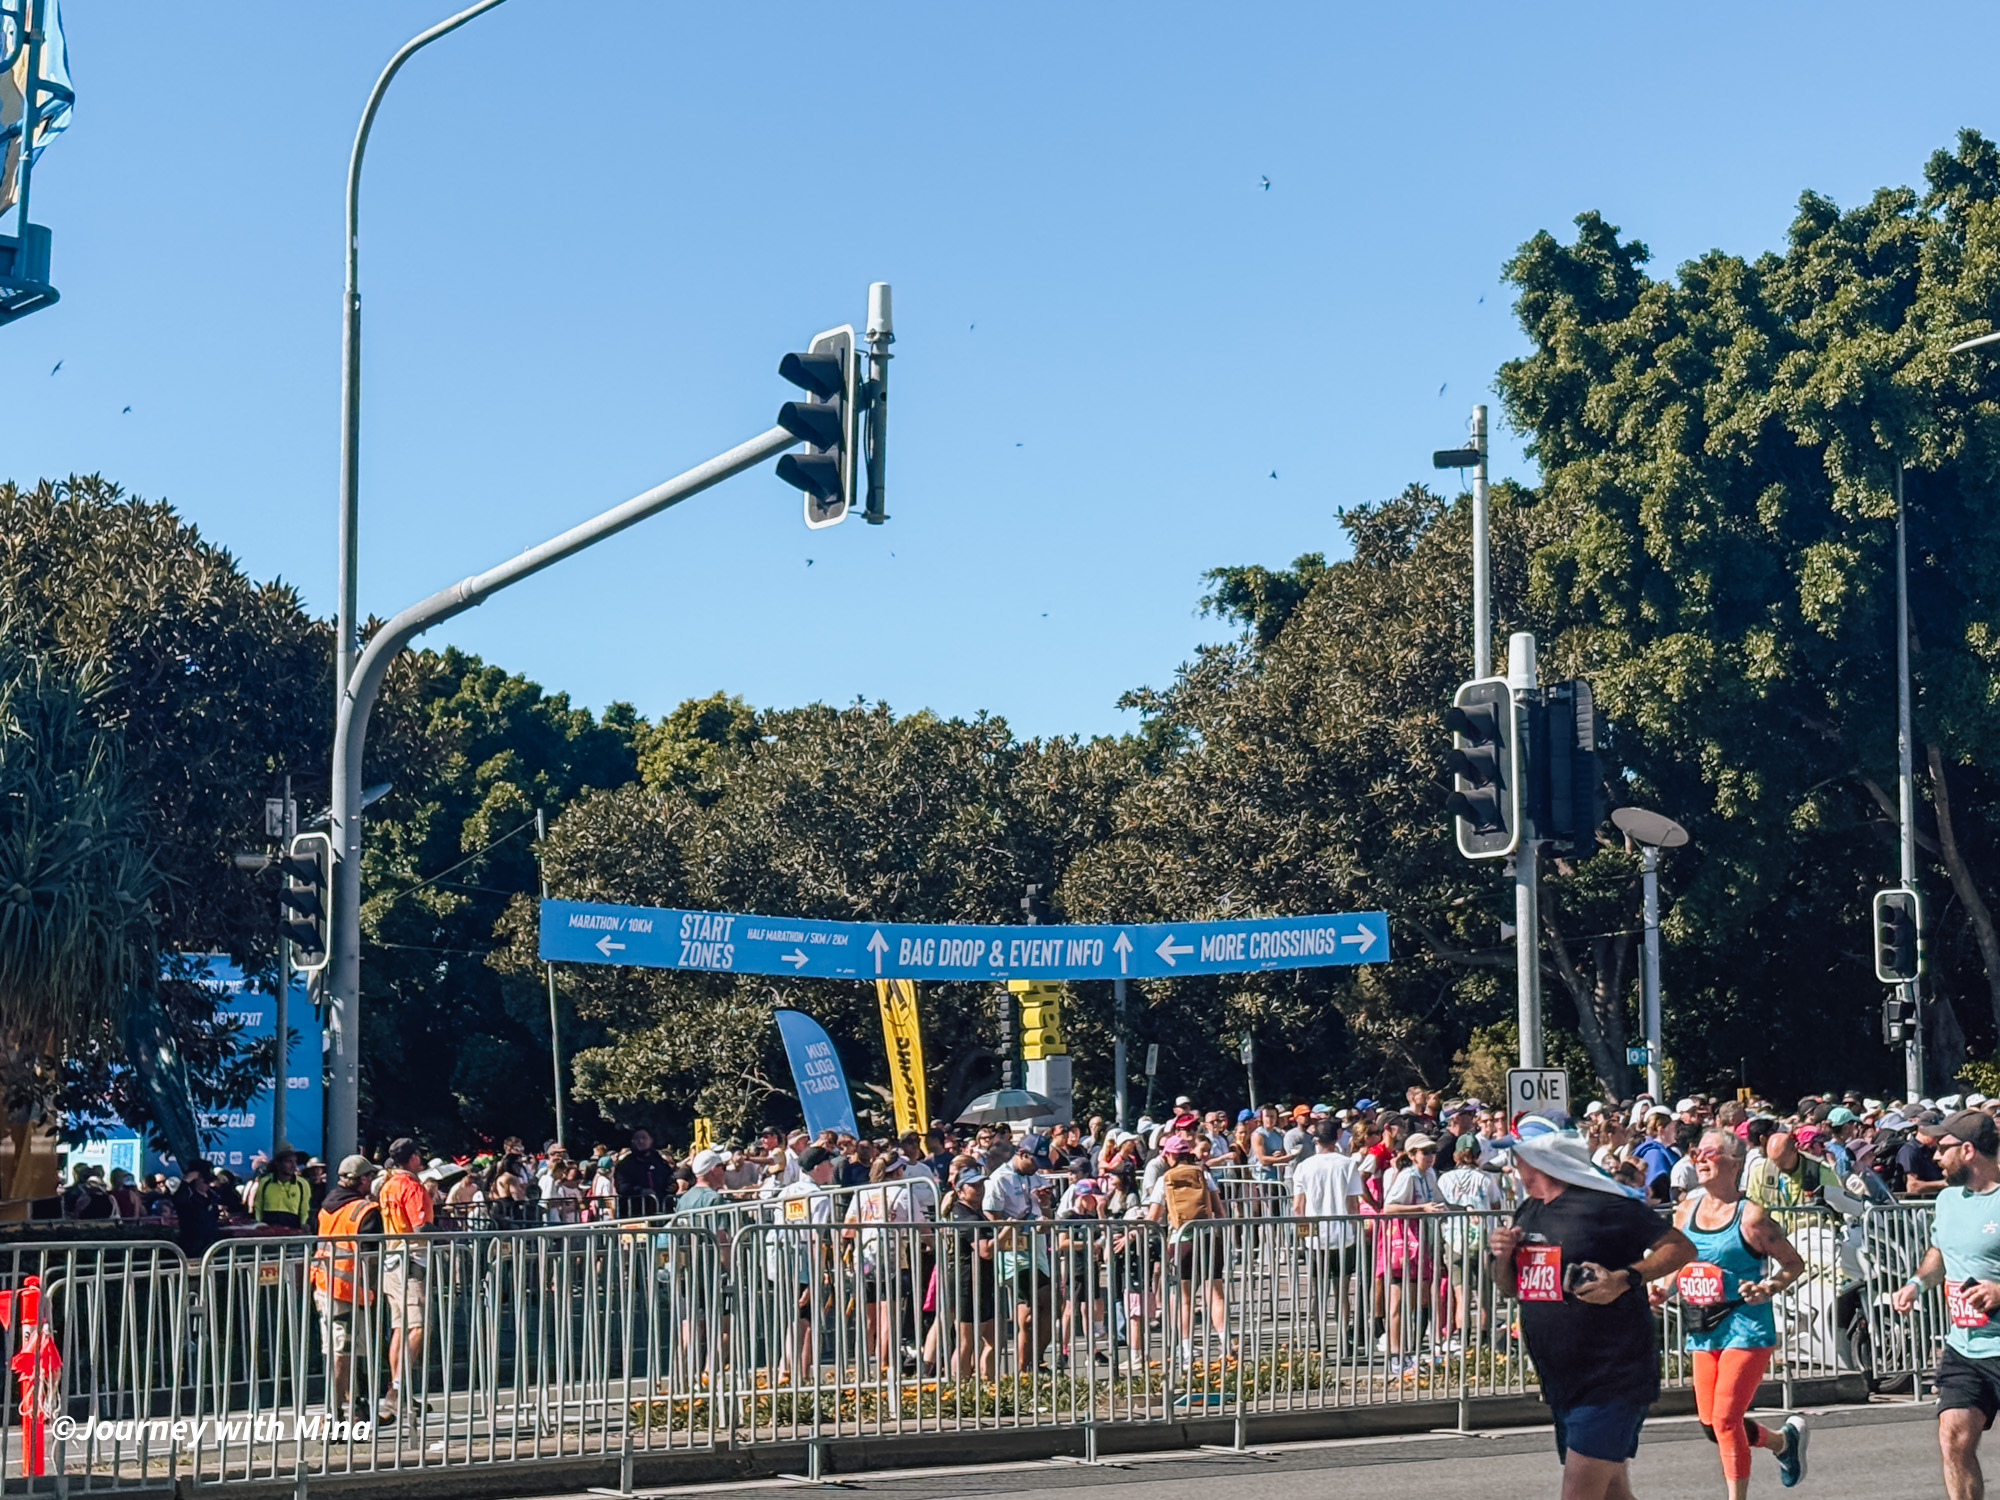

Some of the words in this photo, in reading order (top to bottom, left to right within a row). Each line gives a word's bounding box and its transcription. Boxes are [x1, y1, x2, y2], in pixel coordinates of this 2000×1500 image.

[568, 913, 619, 931] MARATHON
[619, 917, 627, 931] /
[628, 918, 653, 933] 10KM
[680, 913, 735, 942] START
[747, 928, 766, 940] HALF
[766, 929, 804, 943] MARATHON
[810, 932, 826, 945] 5KM
[832, 934, 848, 946] 2KM
[1200, 933, 1246, 962] MORE
[1249, 927, 1336, 959] CROSSINGS
[678, 941, 735, 969] ZONES
[899, 938, 935, 966] BAG
[938, 938, 985, 966] DROP
[988, 939, 1004, 967] &
[1009, 939, 1064, 967] EVENT
[1066, 938, 1103, 966] INFO
[240, 1011, 263, 1026] EXIT
[1520, 1079, 1560, 1101] ONE
[228, 1113, 256, 1128] CLUB
[1521, 1265, 1555, 1290] 51413
[1679, 1277, 1719, 1297] 50302
